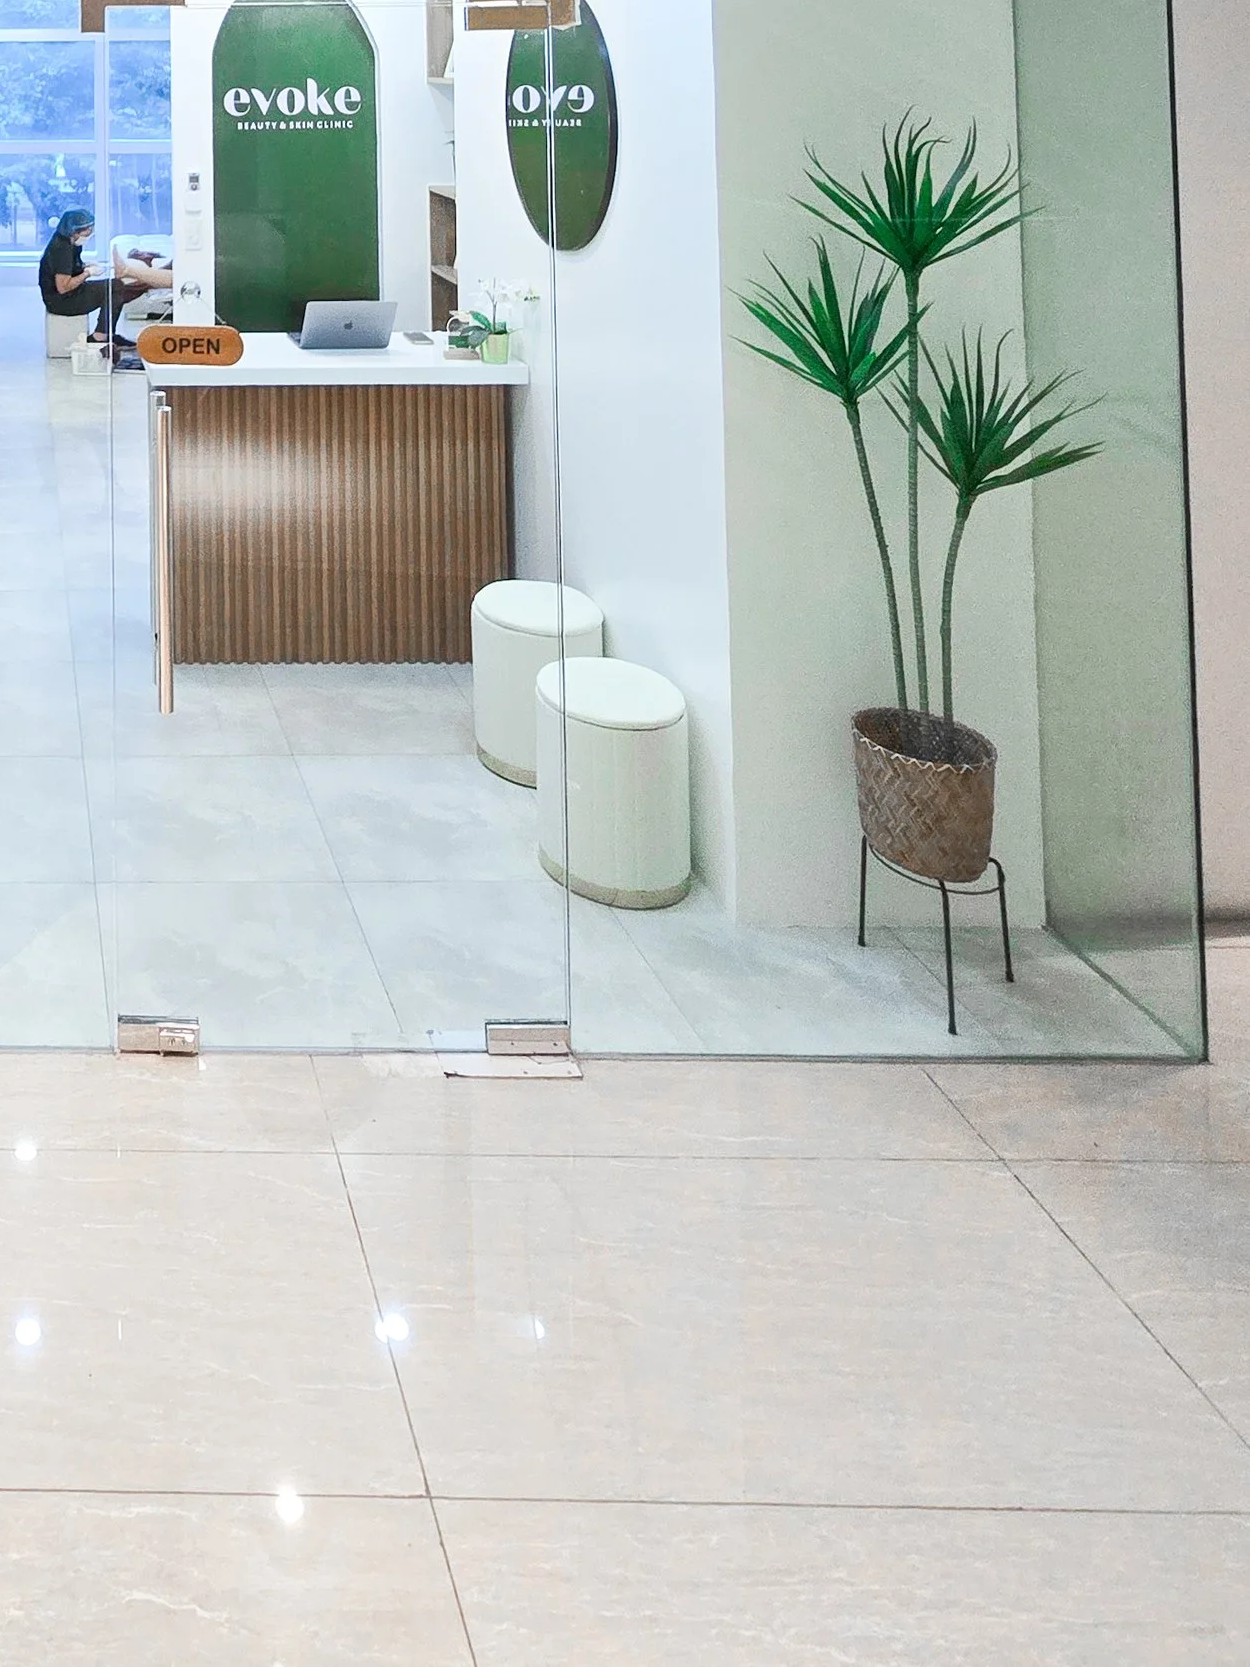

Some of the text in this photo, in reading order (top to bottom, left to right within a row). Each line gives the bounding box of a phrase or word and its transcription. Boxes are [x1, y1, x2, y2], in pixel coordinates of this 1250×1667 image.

[223, 78, 361, 117] evoke
[237, 120, 354, 130] BEAUTY & SKIN CLINIC
[161, 337, 220, 355] OPEN
